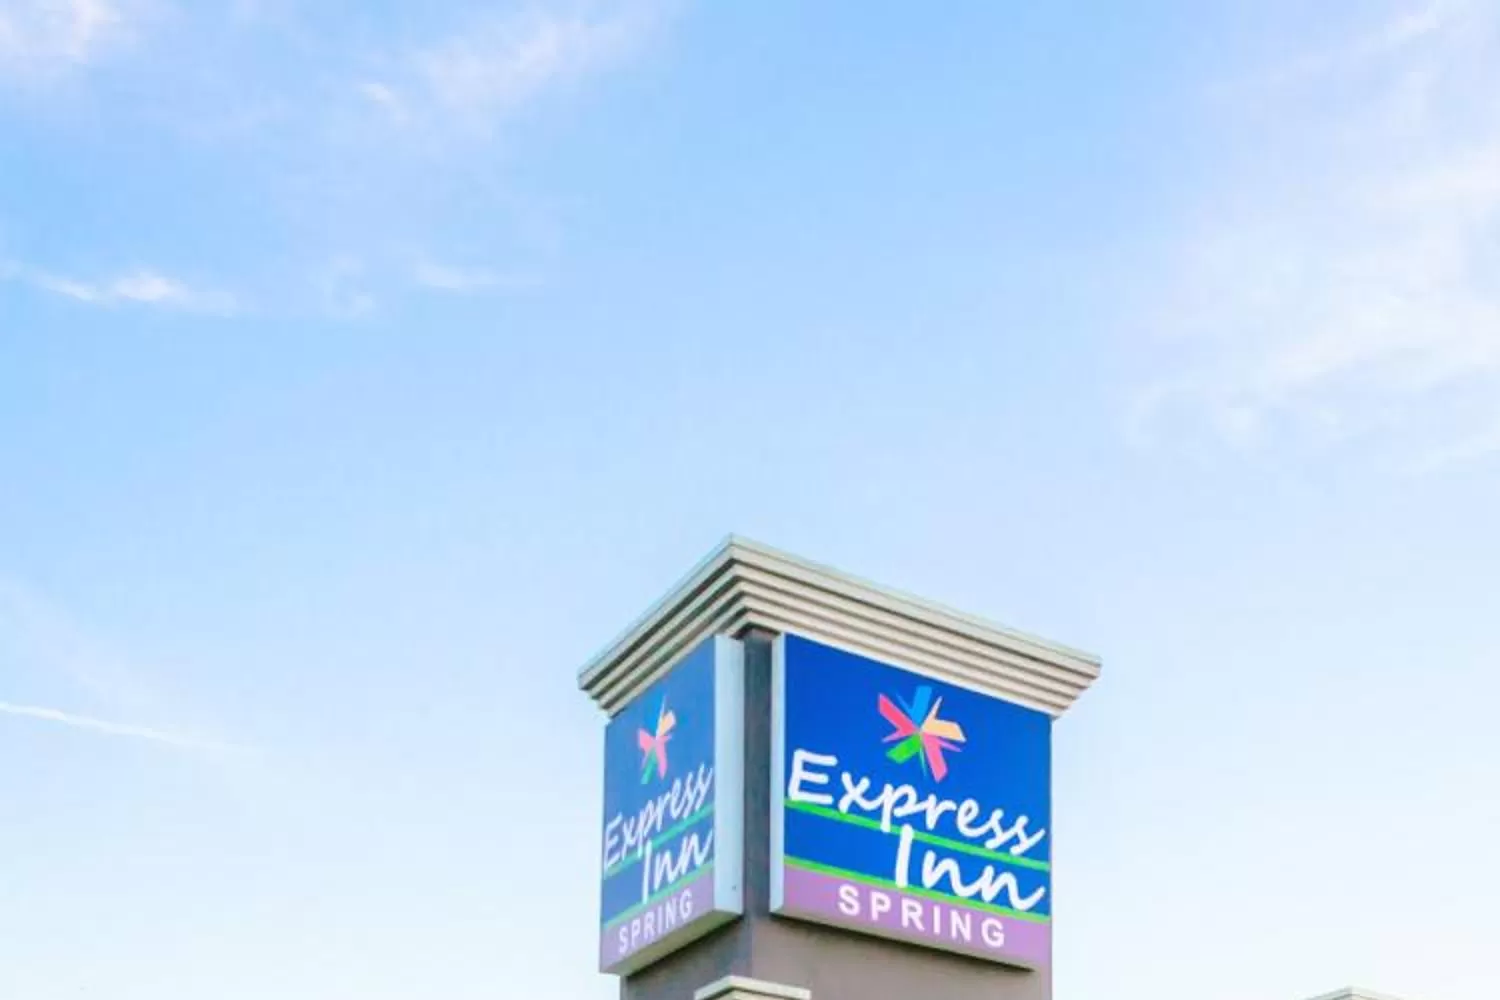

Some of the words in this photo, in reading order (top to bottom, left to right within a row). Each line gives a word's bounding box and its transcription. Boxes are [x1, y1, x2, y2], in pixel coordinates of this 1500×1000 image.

[604, 763, 714, 874] Express
[788, 748, 1046, 856] Express
[641, 828, 714, 905] Inn
[895, 823, 1046, 912] Inn
[619, 889, 694, 954] SPRING
[838, 884, 1006, 948] SPRING
